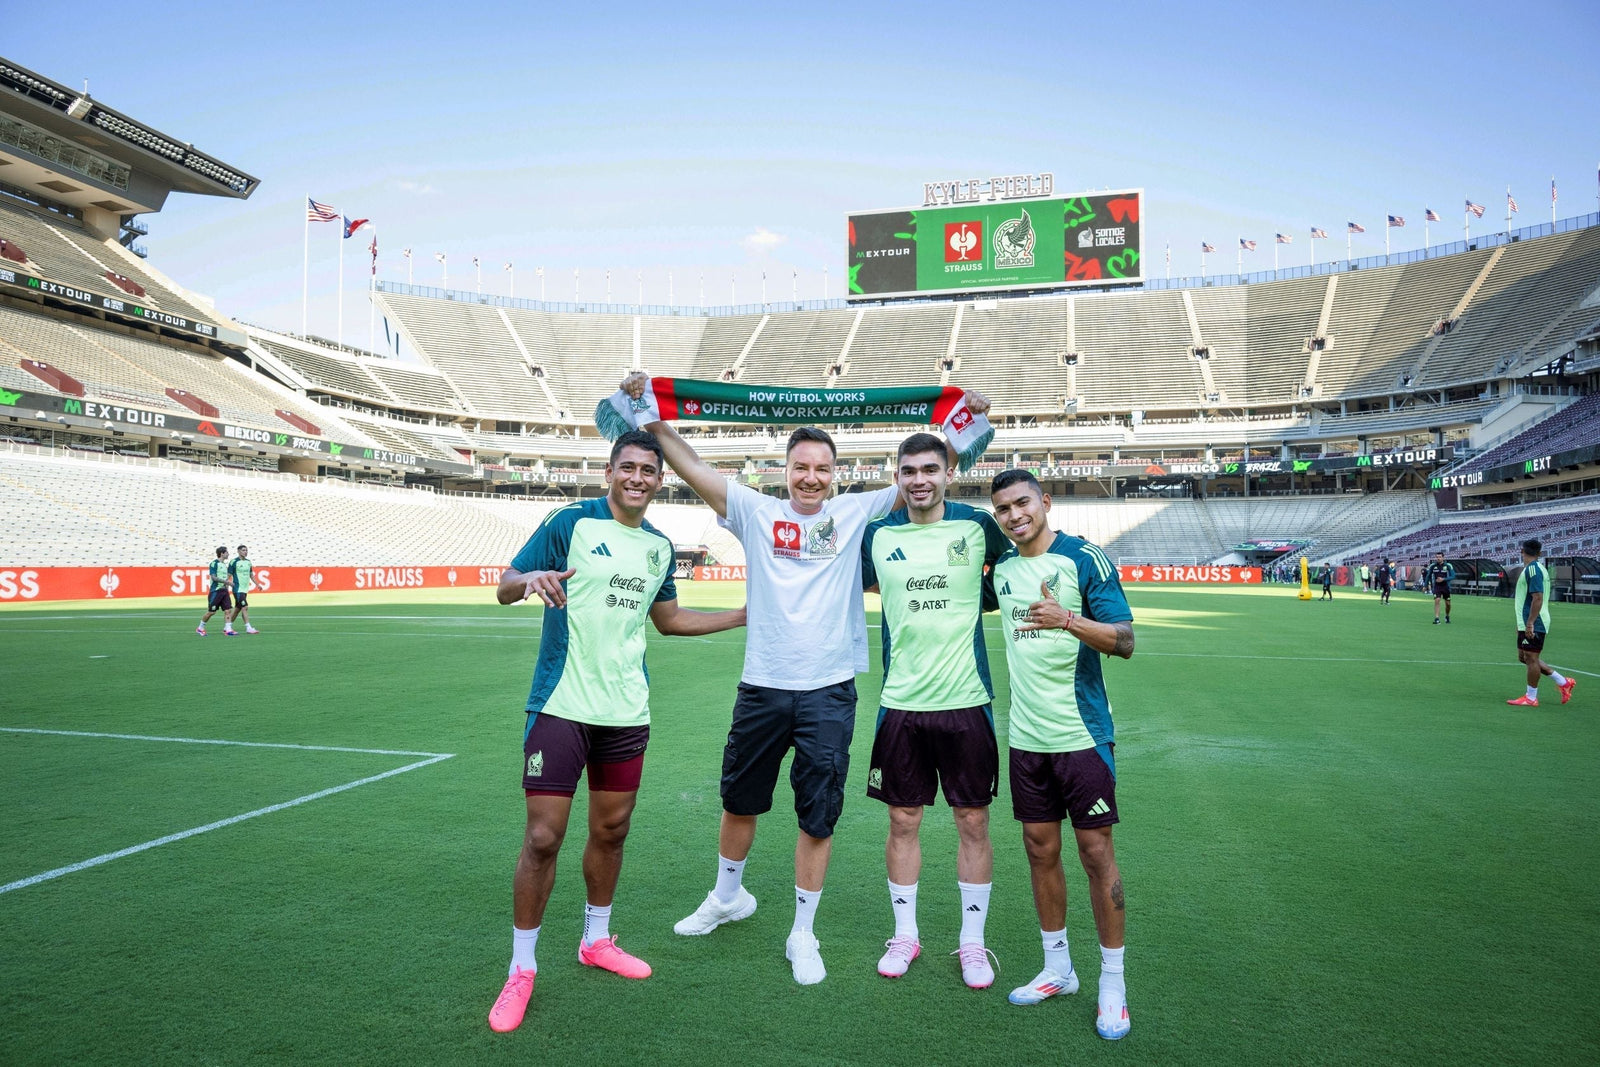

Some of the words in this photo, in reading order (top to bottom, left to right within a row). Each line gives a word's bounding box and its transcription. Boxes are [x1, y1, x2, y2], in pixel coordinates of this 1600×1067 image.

[924, 179, 980, 203] KYLE
[990, 173, 1053, 199] FIELD
[856, 248, 910, 258] MEXTOUR
[944, 263, 983, 272] STRAUSS
[28, 278, 91, 302] MEXTOUR
[134, 307, 186, 327] MEXTOUR
[749, 391, 776, 402] HOW
[779, 391, 822, 402] FÚTBOL
[824, 392, 865, 402] WORKS
[64, 399, 166, 428] MEXTOUR
[702, 402, 767, 417] OFFICIAL
[772, 406, 860, 417] WORKWEAR
[865, 403, 928, 416] PARTNER
[275, 433, 288, 446] VS
[292, 436, 322, 452] BRAZIL
[363, 448, 416, 465] MEXTOUR
[1357, 449, 1436, 466] MEXTOUR
[1028, 467, 1102, 476] MEXTOUR
[1224, 462, 1239, 474] VS
[1245, 461, 1282, 473] BRAZIL
[510, 471, 577, 483] MEXTOUR
[834, 471, 881, 480] XTOUR
[1431, 471, 1483, 489] MEXTOUR
[773, 549, 800, 558] STRAUSS
[355, 568, 424, 588] STRAUSS
[1152, 567, 1232, 581] STRAUSS
[609, 573, 646, 593] Coca-Cola
[906, 574, 947, 591] Coca-Cola
[617, 598, 641, 610] AT&T
[922, 599, 951, 610] AT&T
